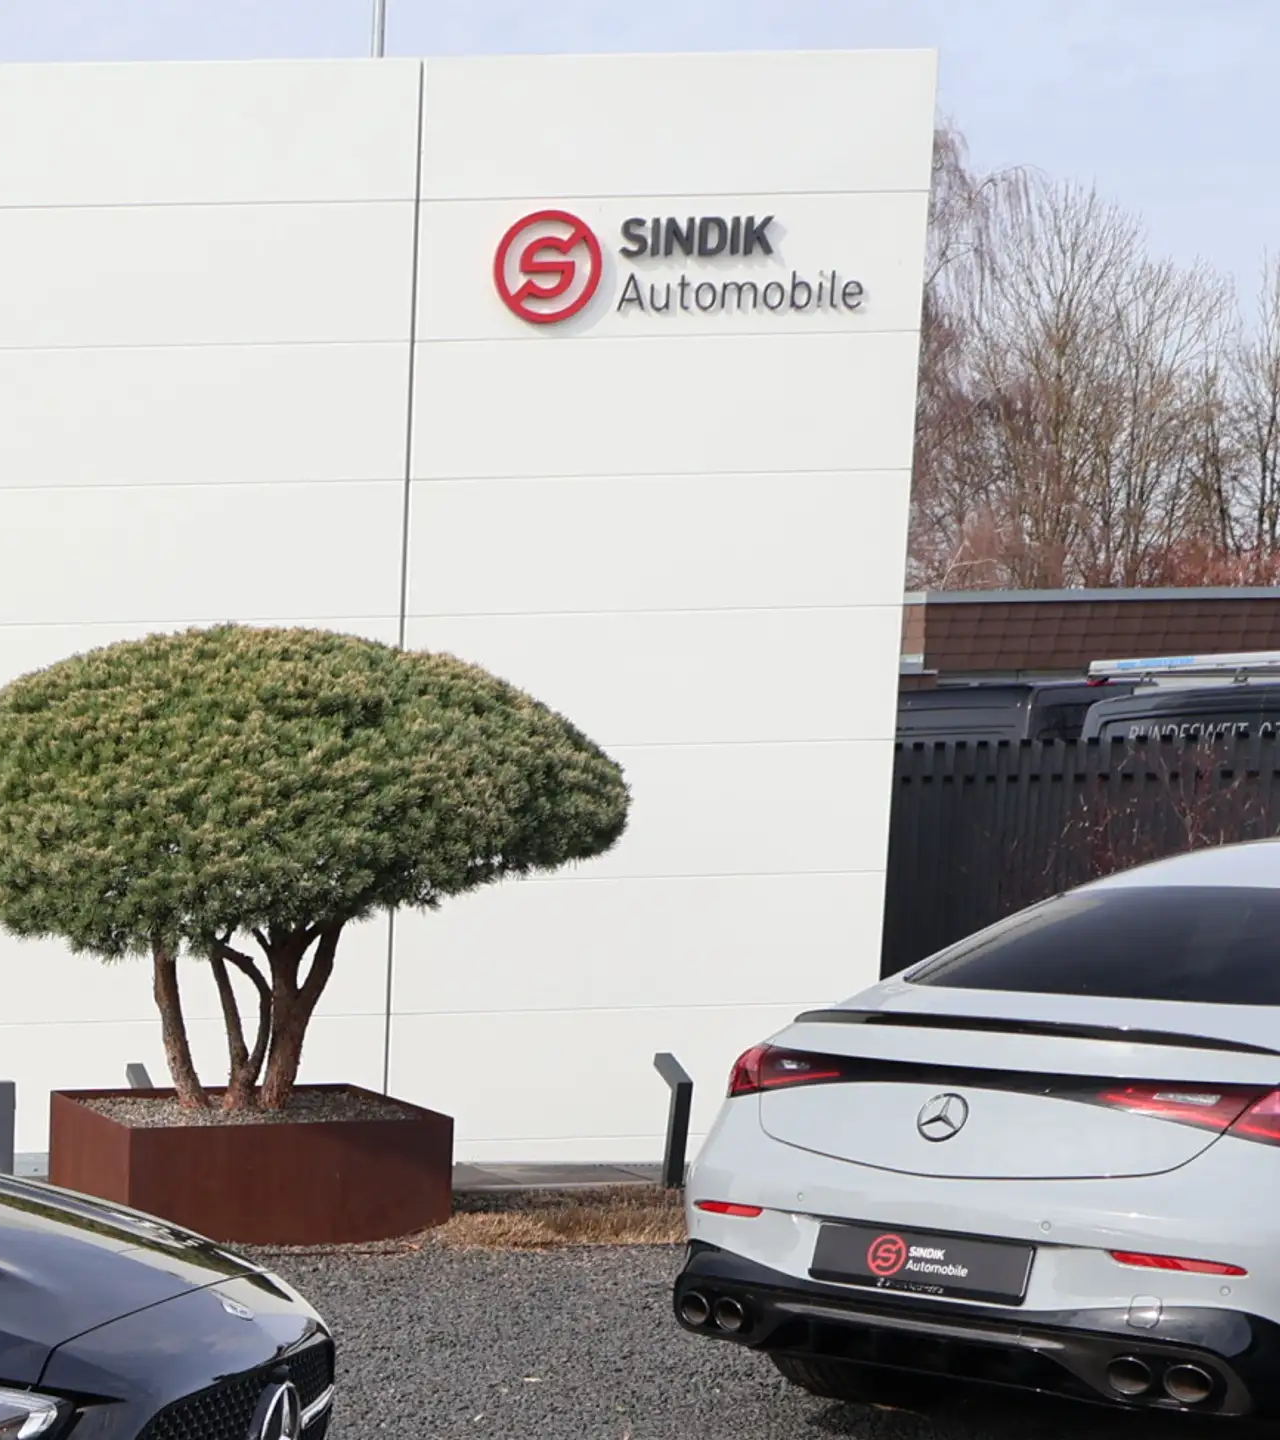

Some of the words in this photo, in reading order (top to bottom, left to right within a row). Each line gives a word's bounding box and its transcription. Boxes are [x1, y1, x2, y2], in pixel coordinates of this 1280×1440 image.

[618, 215, 774, 258] SINDIK
[616, 269, 864, 312] Automobile
[905, 1259, 969, 1277] Automobile
[908, 1246, 946, 1260] SINDIK
